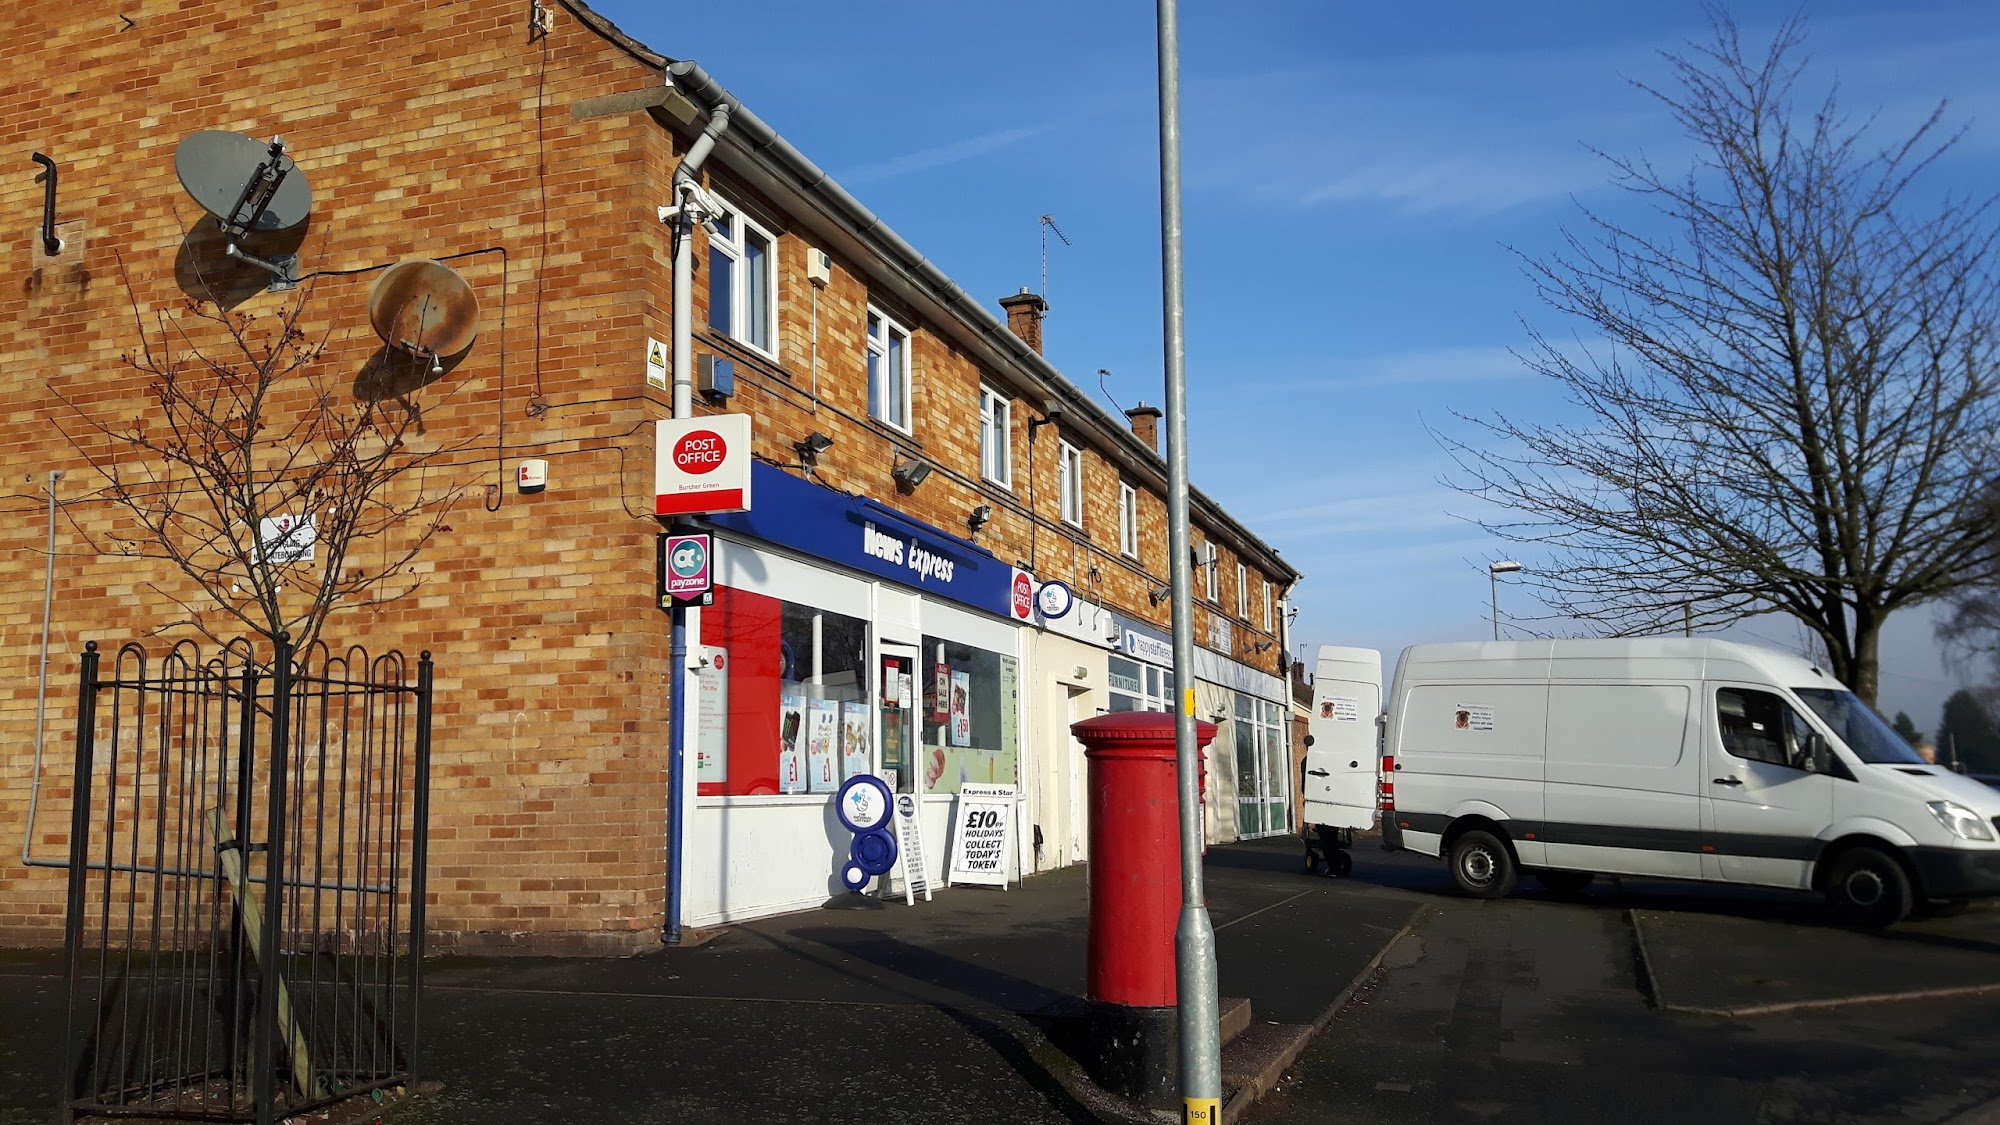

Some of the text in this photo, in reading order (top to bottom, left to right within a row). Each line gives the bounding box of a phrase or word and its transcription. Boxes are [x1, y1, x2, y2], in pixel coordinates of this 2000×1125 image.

[685, 438, 716, 452] POST
[677, 450, 721, 465] OFFICE
[864, 520, 954, 583] News Express
[671, 577, 705, 590] payzone
[1017, 581, 1030, 594] POST
[1014, 594, 1030, 609] OFFICE
[789, 755, 798, 782] £1
[823, 757, 831, 783] £1
[962, 788, 992, 796] Express
[965, 829, 1004, 838] HOLIDAYS
[965, 840, 1003, 849] COLLECT
[965, 850, 1002, 859] TODAY'S
[967, 860, 998, 870] TOKEN
[1190, 1110, 1207, 1119] 150
